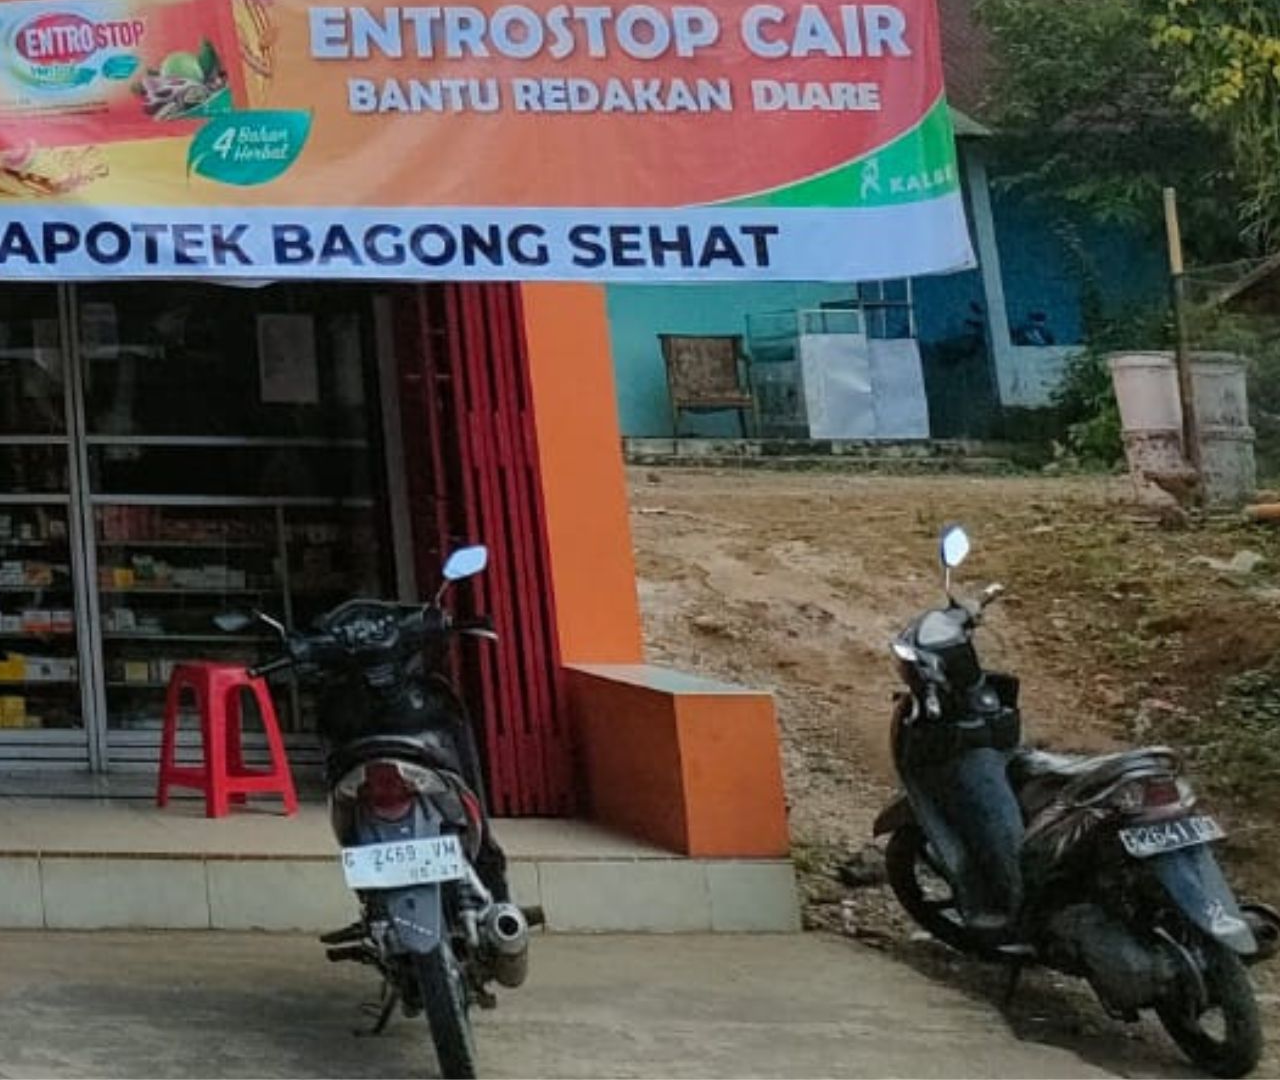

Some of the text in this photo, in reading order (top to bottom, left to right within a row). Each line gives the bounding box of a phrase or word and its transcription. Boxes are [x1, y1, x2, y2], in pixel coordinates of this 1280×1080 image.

[23, 21, 145, 59] ENTROSTOP
[309, 3, 913, 60] ENTROSTOP CAIR
[348, 78, 882, 113] BANTU REDAKAN DIARE
[213, 126, 236, 160] 4
[273, 223, 558, 269] BAGONG
[569, 223, 779, 268] SEHAT
